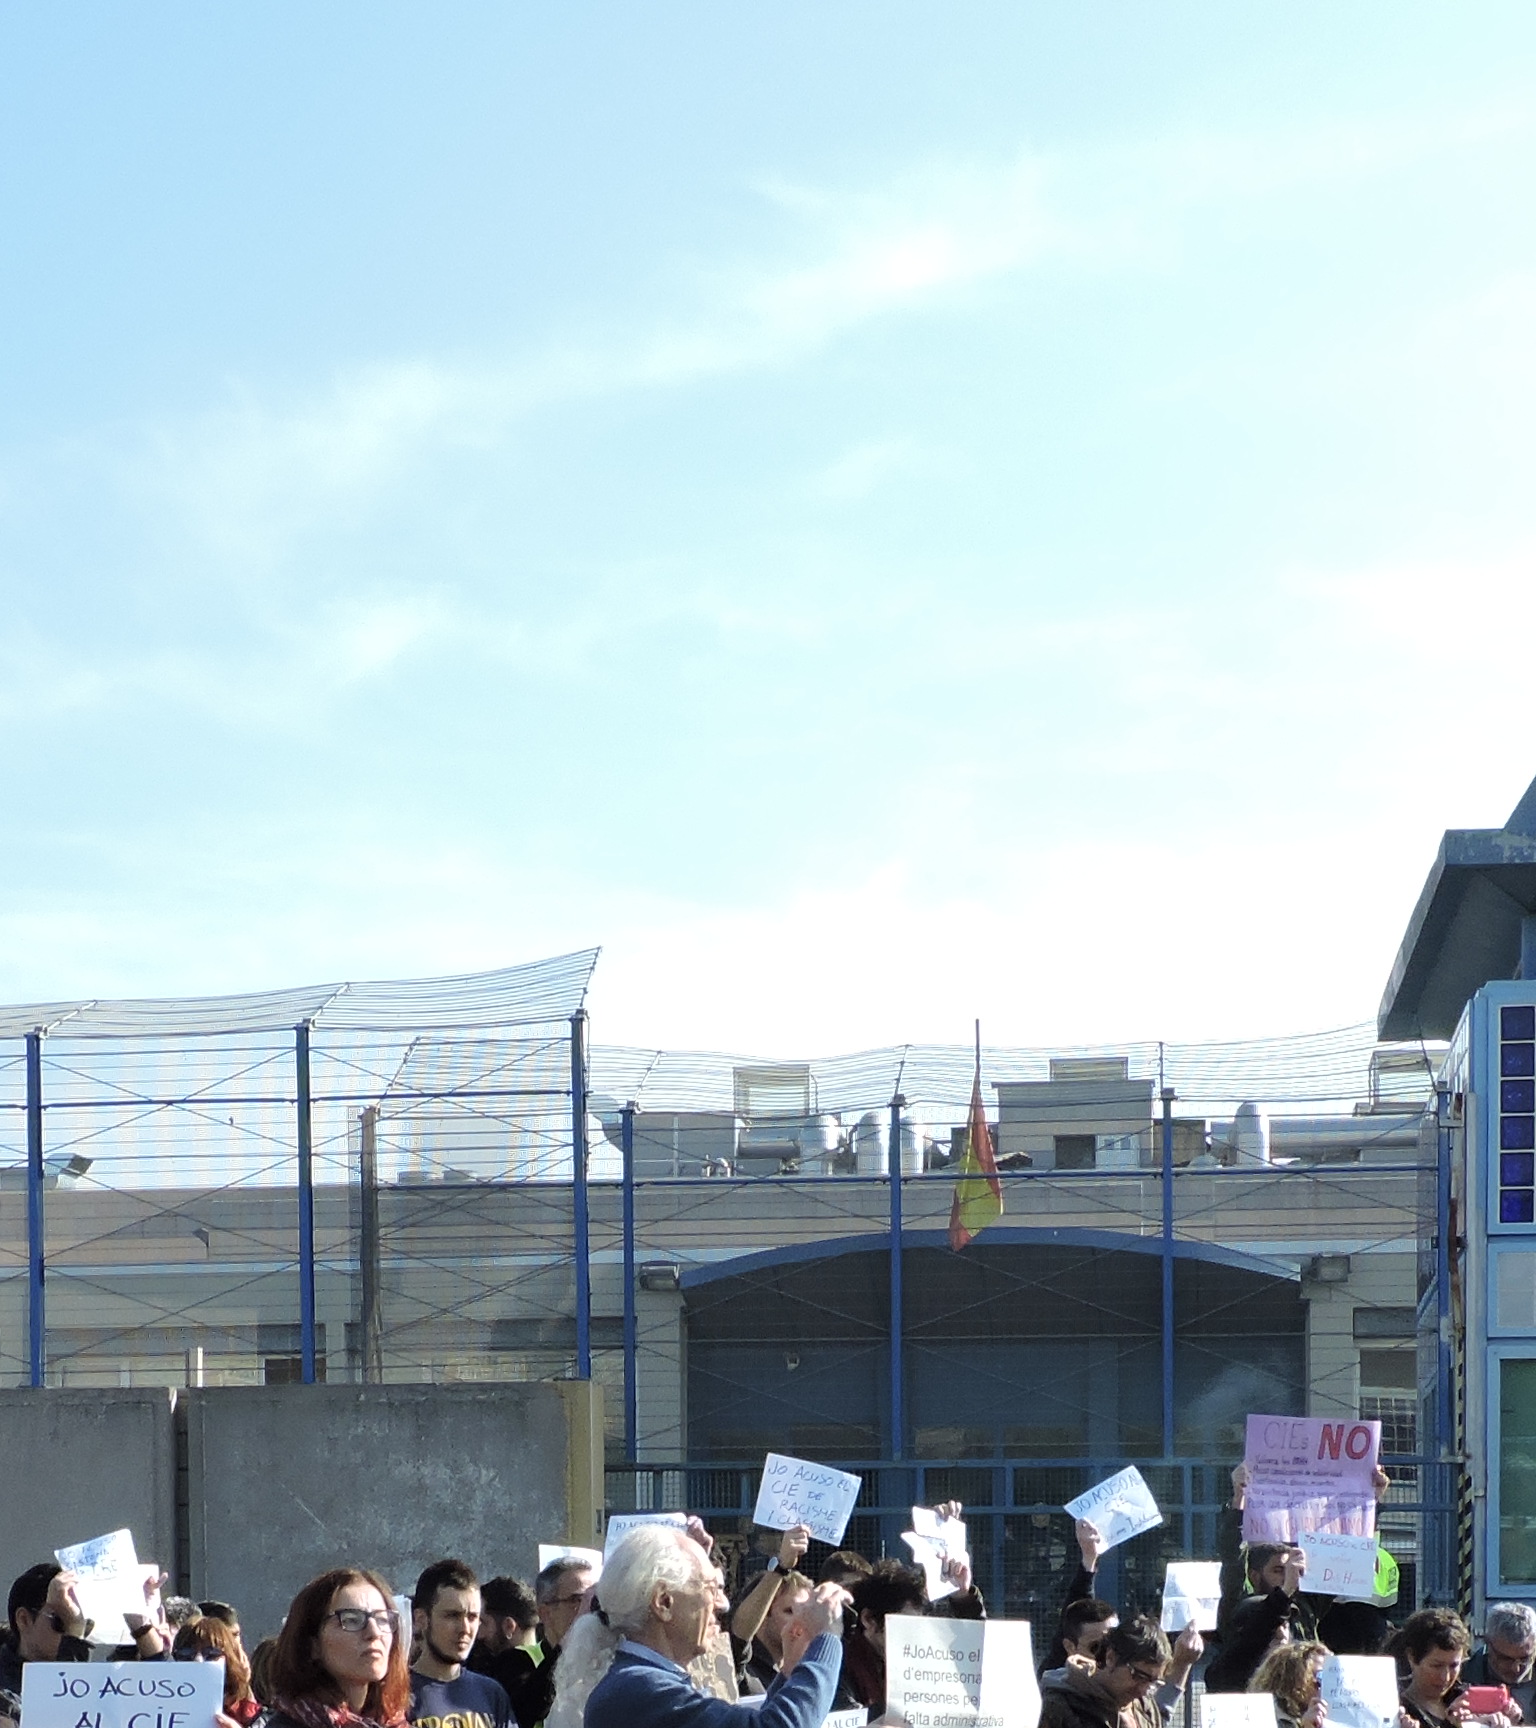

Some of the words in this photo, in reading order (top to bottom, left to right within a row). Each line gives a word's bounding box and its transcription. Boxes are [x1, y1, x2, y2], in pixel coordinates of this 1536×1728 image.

[1316, 1423, 1372, 1460] NO
[771, 1480, 800, 1497] CIE
[902, 1644, 964, 1663] #JoAcuso
[968, 1648, 981, 1663] el
[902, 1666, 982, 1685] d'empresona
[98, 1675, 196, 1699] ACUSO
[903, 1691, 960, 1706] persones
[963, 1693, 979, 1707] pe
[903, 1710, 930, 1726] falta
